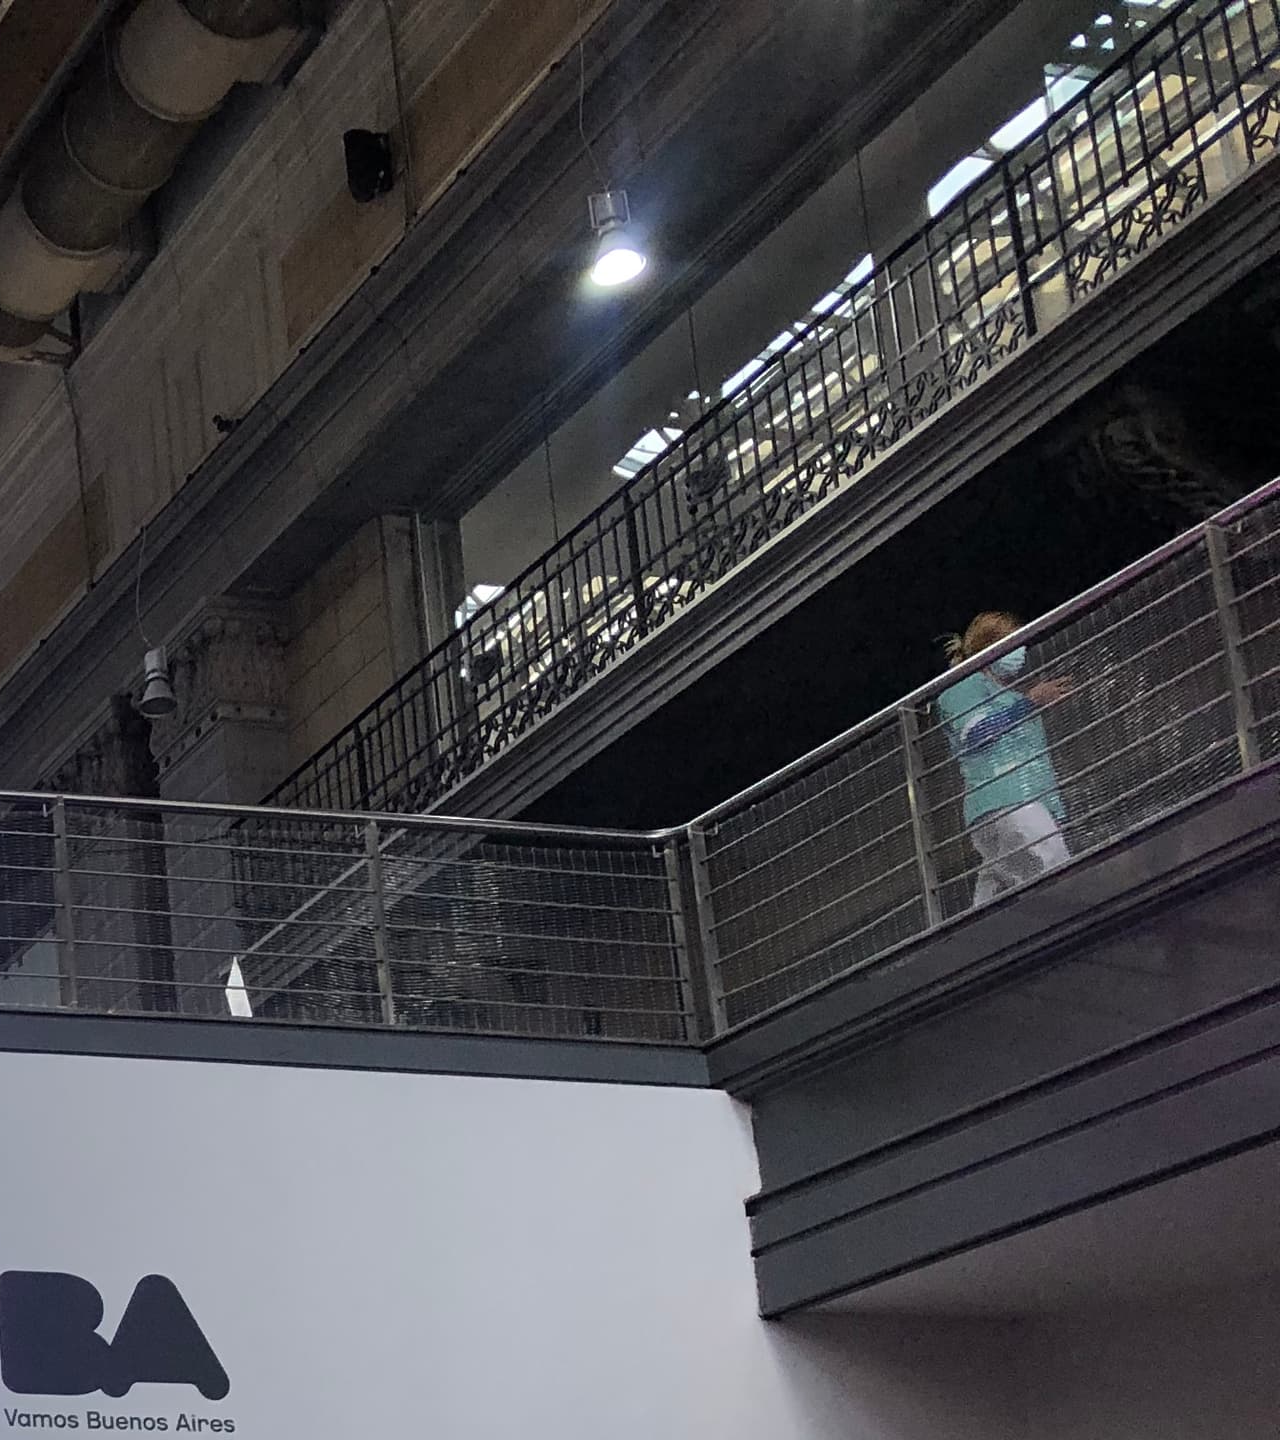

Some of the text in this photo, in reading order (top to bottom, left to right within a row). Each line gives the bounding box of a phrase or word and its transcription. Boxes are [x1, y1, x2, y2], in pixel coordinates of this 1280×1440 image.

[3, 1407, 236, 1434] Vamos Buenos Aires
